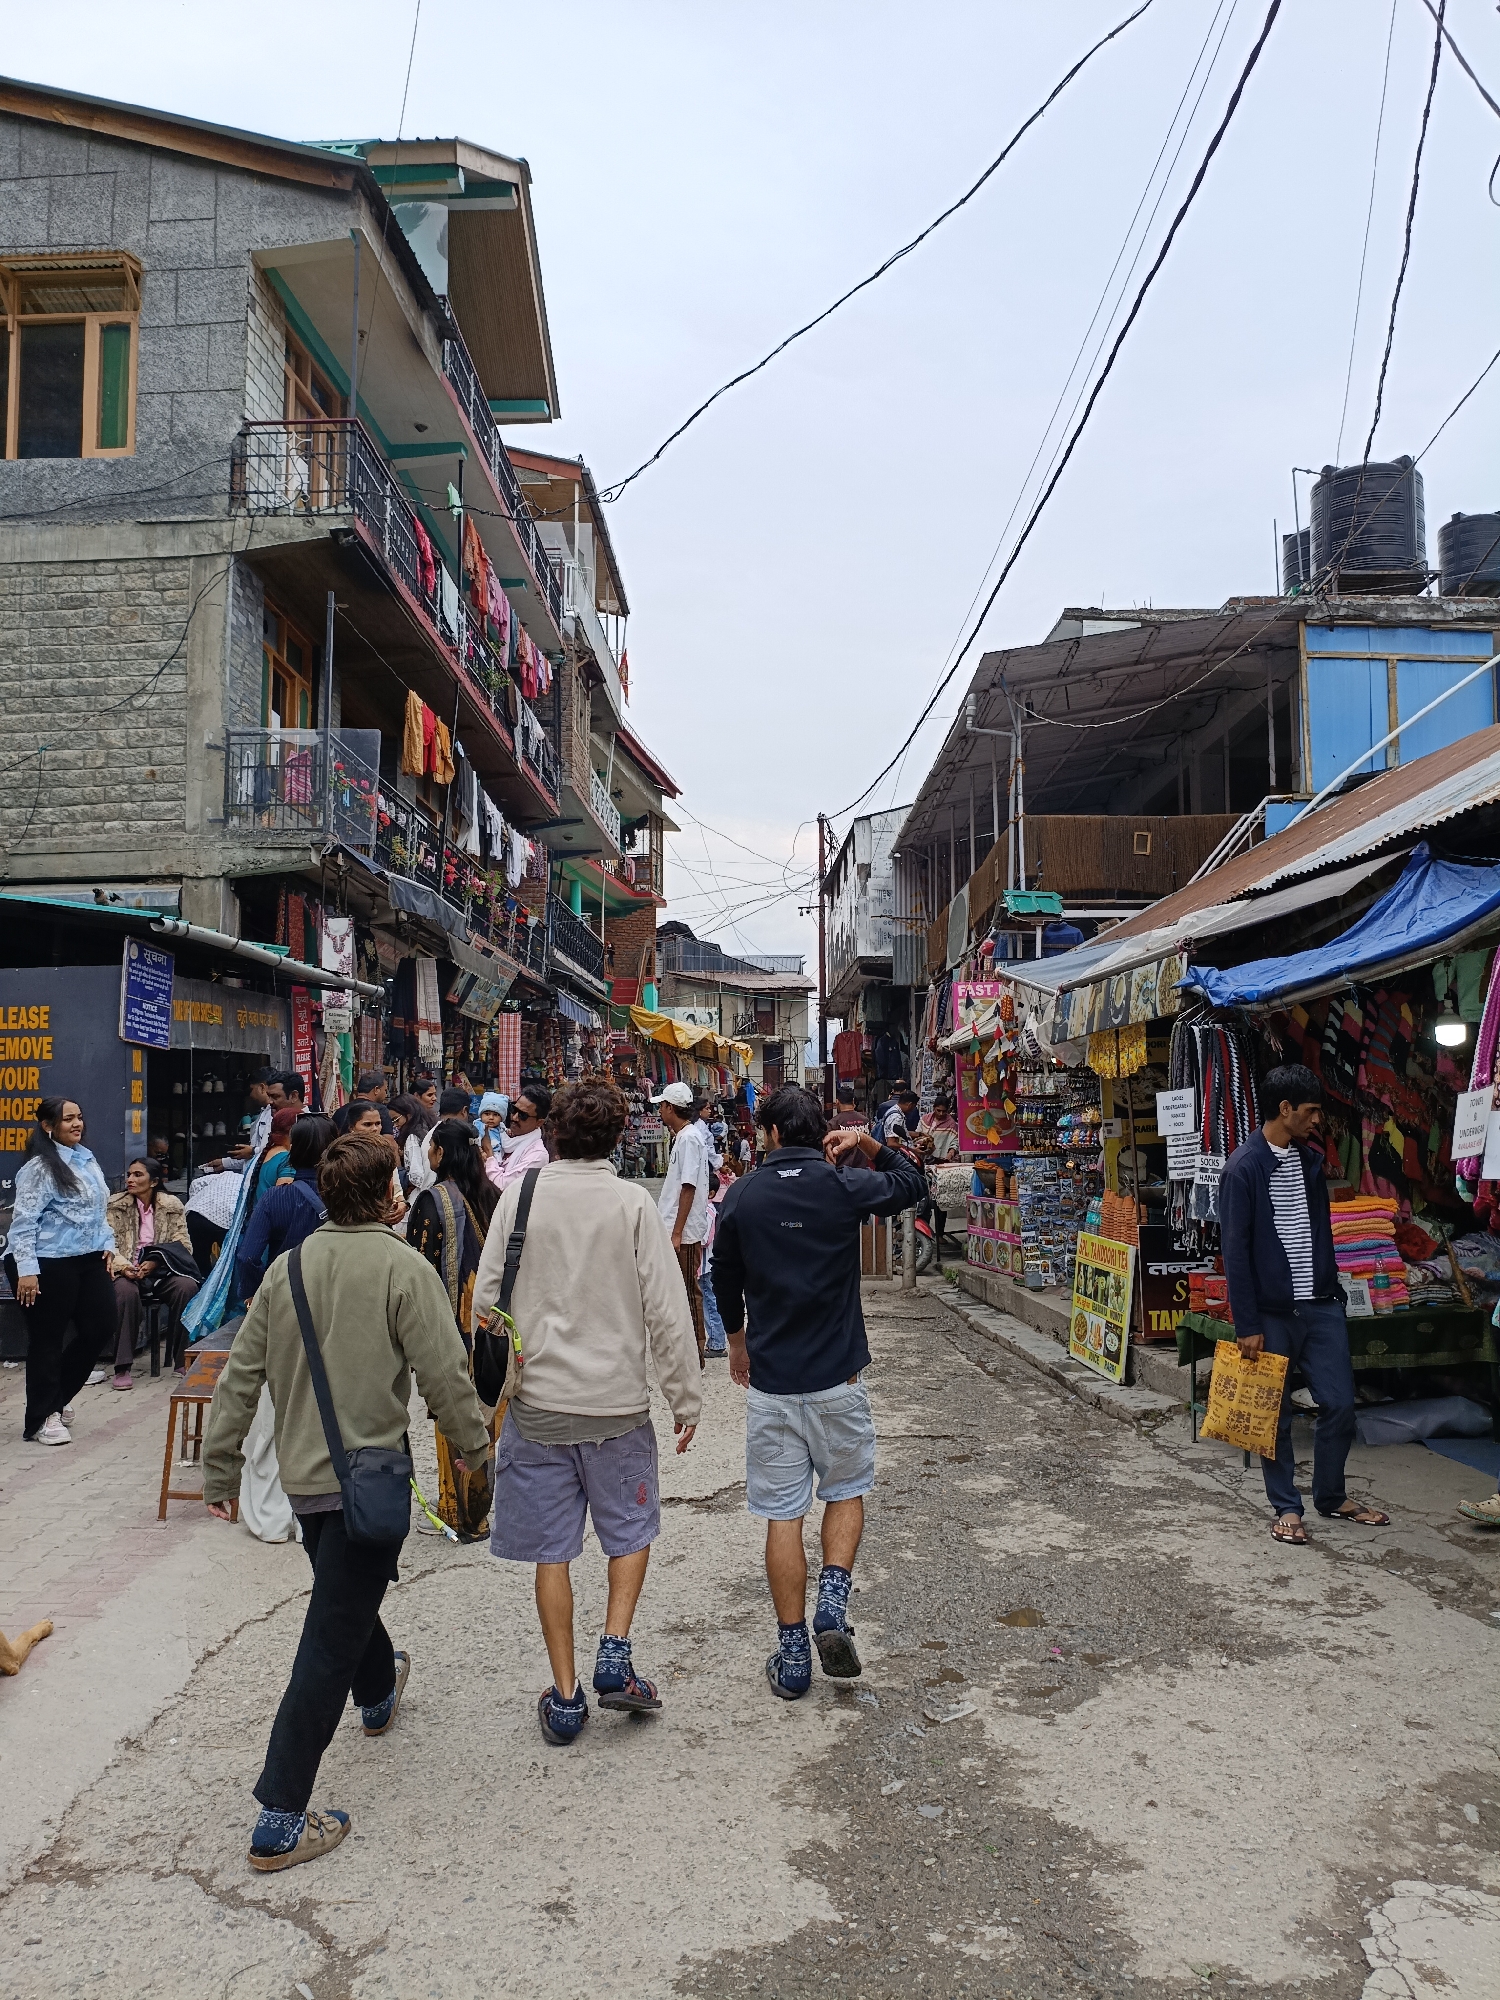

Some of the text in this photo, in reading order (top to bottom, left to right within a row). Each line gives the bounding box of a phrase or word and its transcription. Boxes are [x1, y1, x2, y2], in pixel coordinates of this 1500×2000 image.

[144, 948, 167, 966] सूचना
[958, 984, 994, 997] FAST
[0, 1005, 49, 1029] LEASE
[142, 1002, 158, 1013] NOTICE
[0, 1036, 53, 1060] EMOVE
[296, 1053, 311, 1063] PLEASE
[0, 1066, 40, 1091] YOUR
[0, 1096, 43, 1121] HOES
[1135, 1124, 1158, 1134] RABR
[1200, 1157, 1220, 1167] SOCKS
[1118, 1250, 1128, 1271] TEA
[1148, 1309, 1187, 1331] TAN
